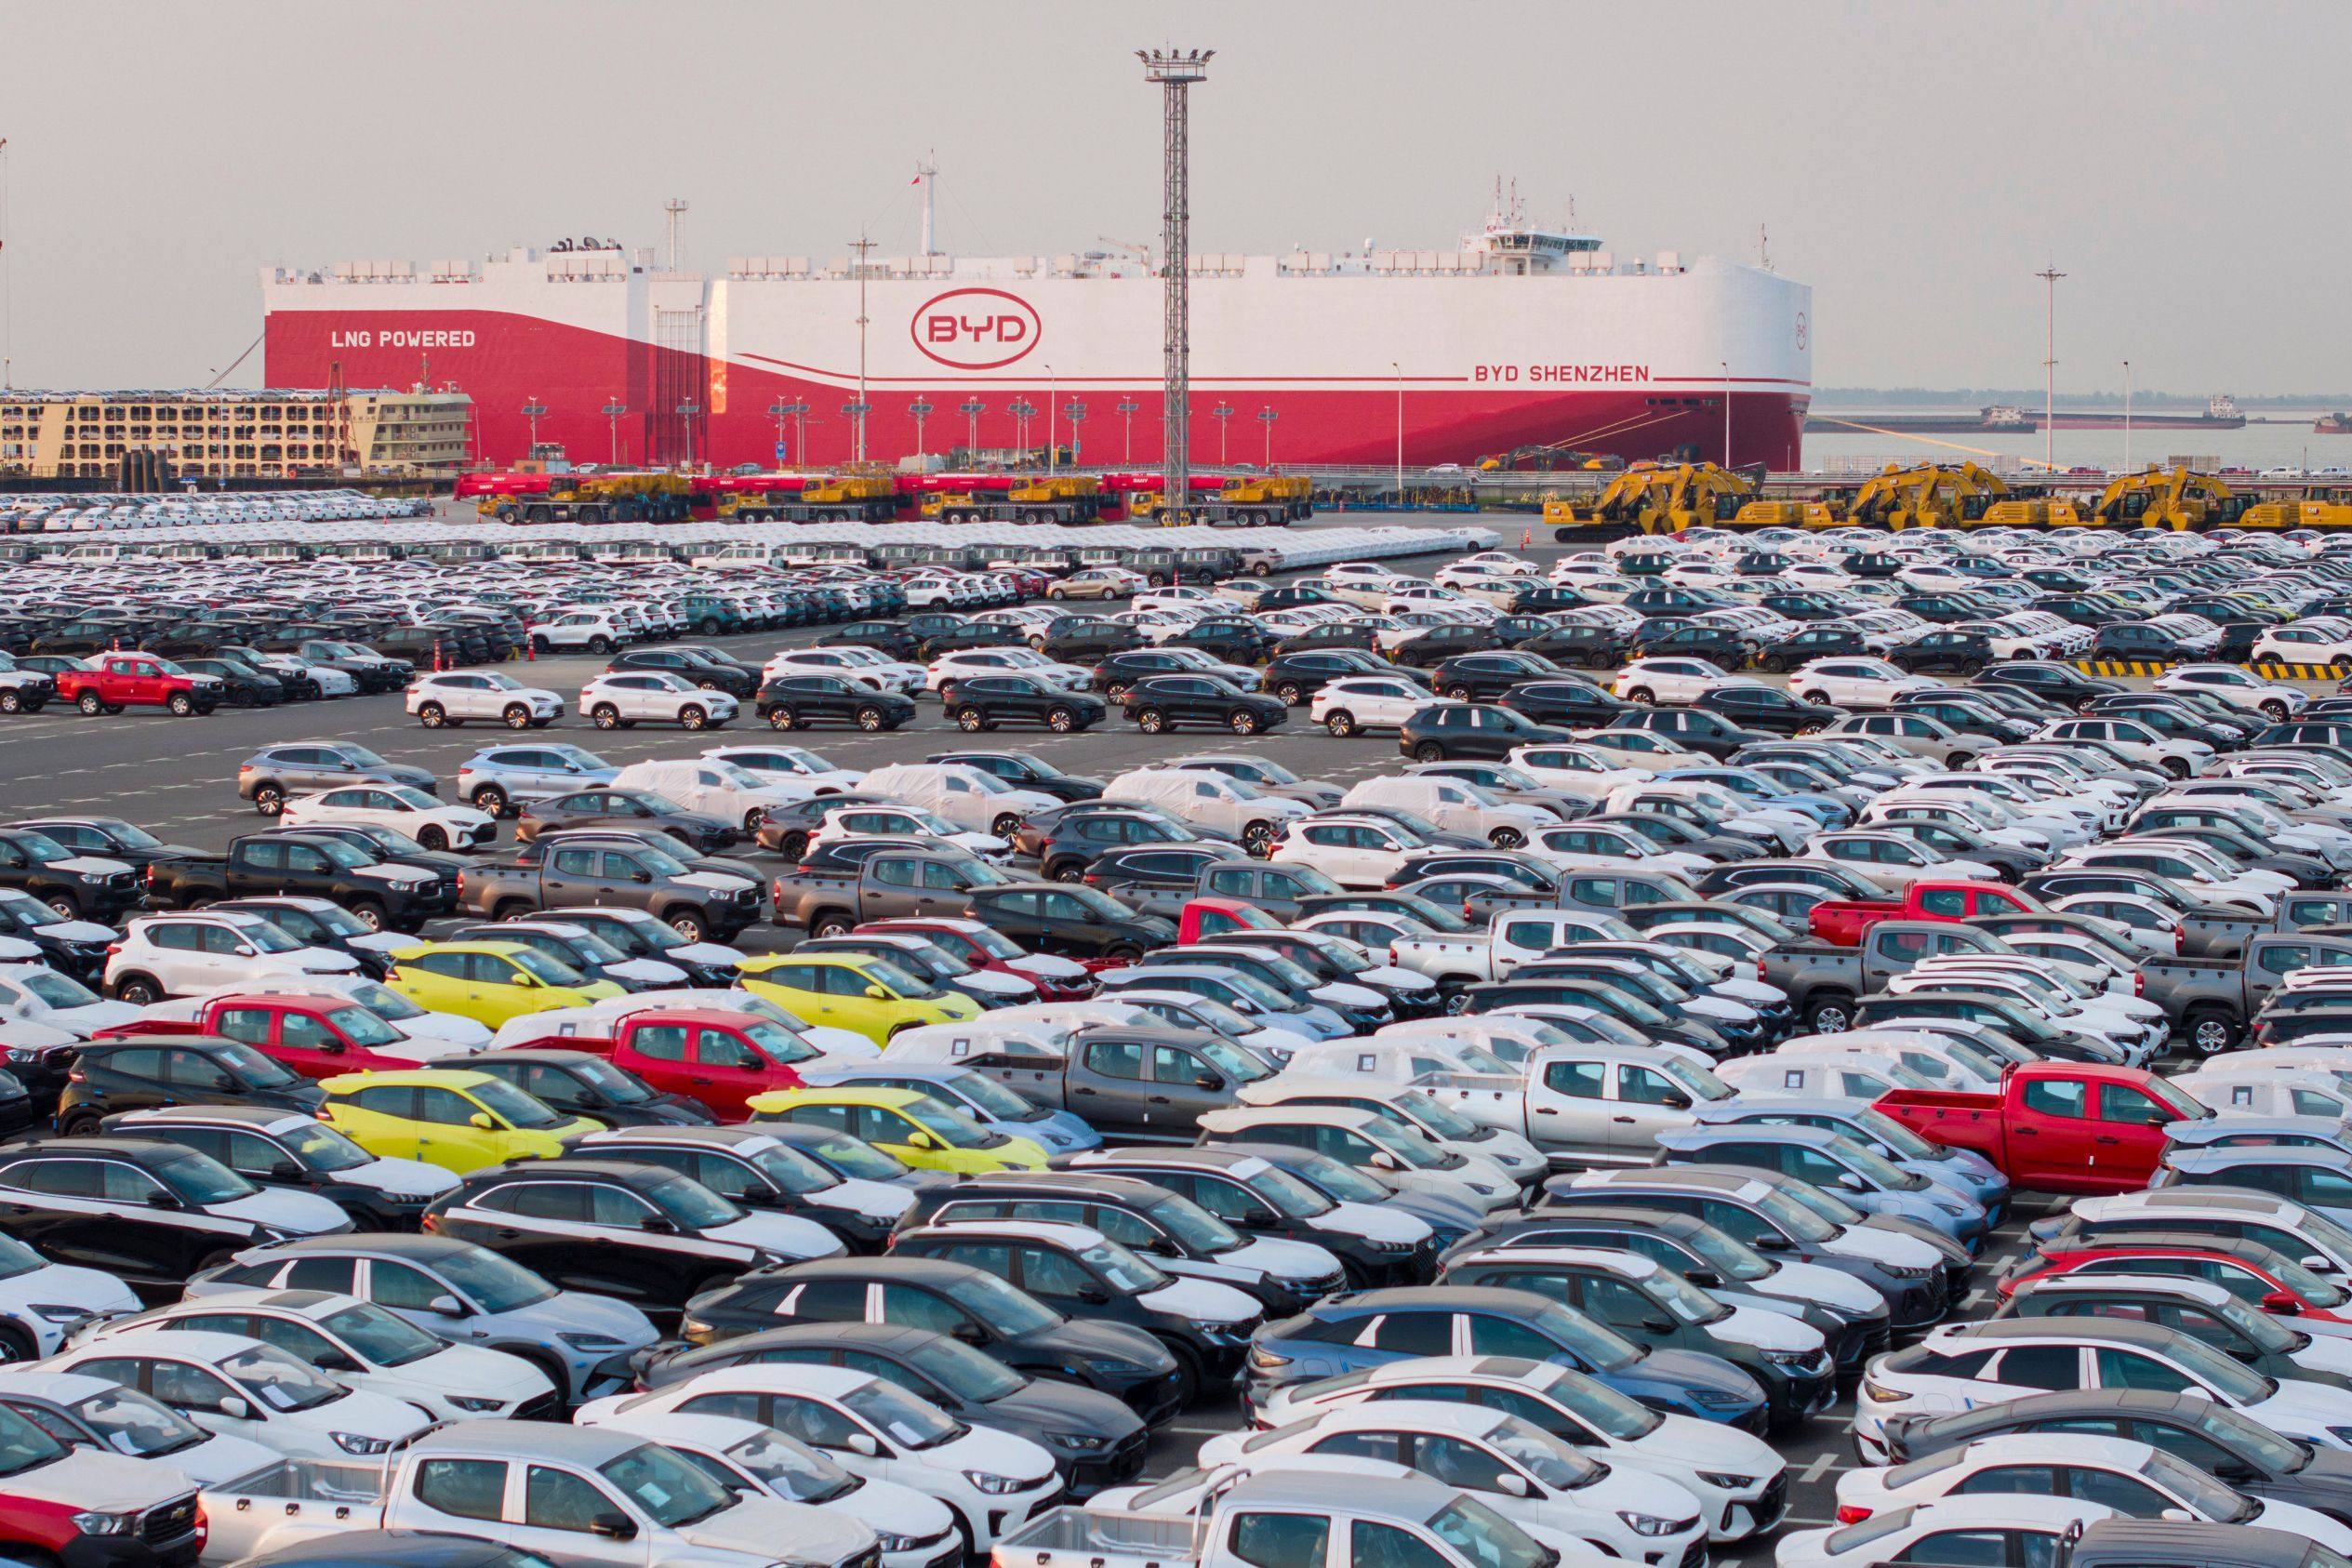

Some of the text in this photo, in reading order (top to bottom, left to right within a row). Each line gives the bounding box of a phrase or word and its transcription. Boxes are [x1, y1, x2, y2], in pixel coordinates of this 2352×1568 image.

[929, 315, 1027, 342] BYD
[332, 330, 475, 347] LNG POWERED
[1475, 365, 1649, 382] BYD SHENZHEN
